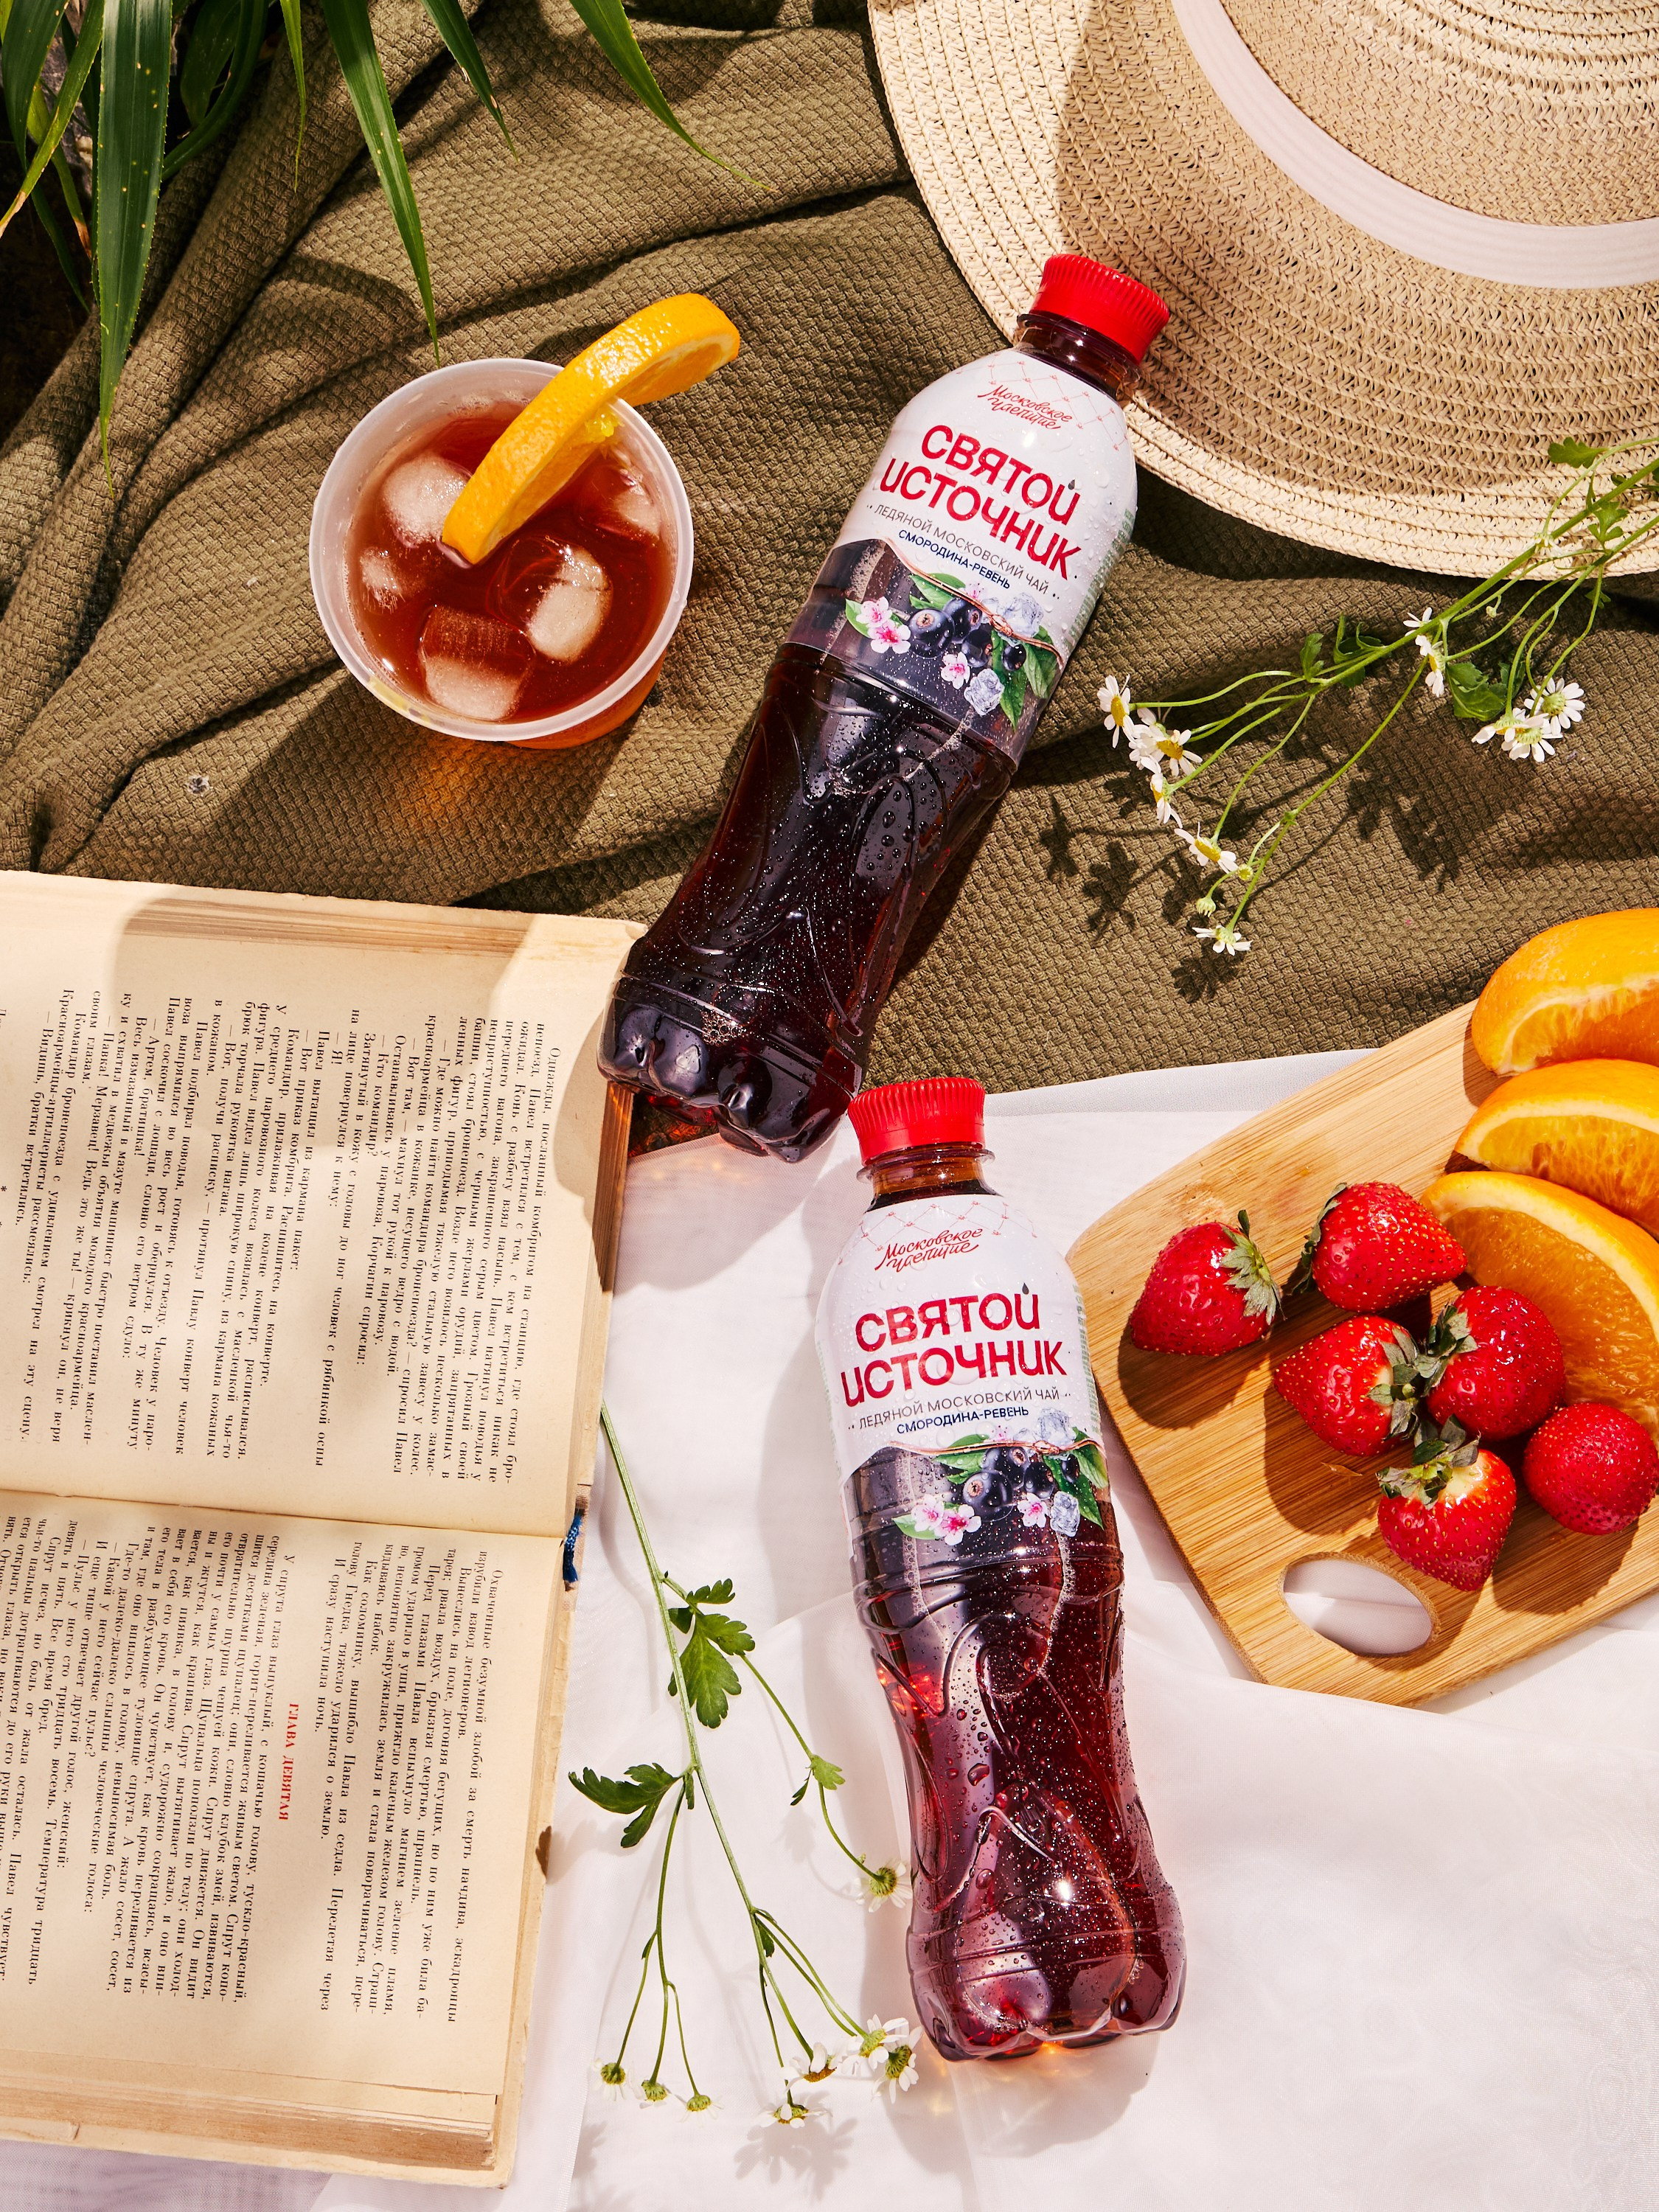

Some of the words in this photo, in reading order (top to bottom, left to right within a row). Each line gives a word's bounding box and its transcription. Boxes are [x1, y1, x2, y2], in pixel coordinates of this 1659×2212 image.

[978, 384, 1073, 422] Московское
[921, 425, 1081, 526] СВЯТОЙ
[880, 457, 1082, 581] ИСТОЧНИК
[874, 504, 933, 533] ЛЕДЯНОЙ
[933, 526, 1026, 580] МОСКОВСКИЙ
[1025, 572, 1048, 595] ЧАЙ
[898, 529, 1012, 590] СМОРОДИНА-РЕВЕНЬ
[120, 993, 132, 1009] ку
[113, 1031, 127, 1082] схватил
[192, 1021, 209, 1061] Павел
[278, 1029, 300, 1099] Командир,
[314, 1031, 330, 1070] Павел
[417, 1015, 437, 1116] красноармейца
[468, 1018, 486, 1065] башни,
[499, 1020, 514, 1087] переднего
[35, 989, 74, 1190] Красноармейцы-артиллеристы
[183, 1068, 200, 1129] подбирал
[384, 1035, 407, 1144] Останавливаясь
[465, 1073, 477, 1110] стоял
[542, 1048, 561, 1113] Однажды,
[307, 1079, 321, 1138] вытащил
[492, 1097, 506, 1146] вагона,
[101, 1105, 117, 1167] медвежьи
[268, 1112, 287, 1193] прилаживая
[304, 1146, 313, 1160] из
[455, 1119, 476, 1197] бронепоезд.
[535, 1123, 550, 1197] посланный
[174, 1136, 191, 1191] поводья,
[407, 1139, 423, 1200] кожанке,
[92, 1175, 110, 1228] объятия
[265, 1206, 275, 1220] на
[296, 1168, 310, 1222] кармана
[372, 1166, 389, 1227] паровоза,
[482, 1156, 500, 1249] закрашенного
[22, 1197, 42, 1284] рассмеялись:
[167, 1197, 182, 1253] готовясь
[290, 1230, 303, 1270] пакет:
[400, 1207, 415, 1270] несущего
[451, 1206, 467, 1244] Возле
[526, 1206, 542, 1276] комбригом
[874, 1228, 983, 1270] Московское
[83, 1236, 99, 1295] молодого
[165, 1260, 173, 1268] к
[258, 1233, 271, 1277] колене
[364, 1236, 384, 1299] Корчагин
[447, 1251, 457, 1280] него
[476, 1259, 488, 1299] серым
[155, 1273, 171, 1328] отъезду.
[247, 1290, 263, 1345] конверт,
[392, 1277, 406, 1314] ведро
[439, 1288, 453, 1346] возилось
[523, 1285, 532, 1300] на
[855, 1282, 1040, 1352] СВЯТОЙ
[69, 1302, 90, 1410] красноармейца.
[356, 1306, 371, 1365] спросил:
[386, 1335, 400, 1377] водой.
[468, 1311, 482, 1361] цветом.
[515, 1309, 529, 1370] станцию,
[149, 1337, 167, 1393] Человек
[431, 1355, 445, 1425] несколько
[511, 1379, 521, 1400] где
[841, 1340, 1068, 1408] ИСТОЧНИК
[145, 1398, 156, 1407] у
[237, 1359, 255, 1459] расписывался.
[461, 1372, 479, 1430] Грозный
[507, 1408, 518, 1446] стоял
[859, 1400, 923, 1429] ЛЕДЯНОЙ
[928, 1387, 1032, 1412] МОСКОВСКИЙ
[1035, 1386, 1060, 1401] ЧАЙ
[897, 1405, 1029, 1434] СМОРОДИНА-РЕВЕНЬ
[457, 1441, 468, 1479] своей
[63, 1520, 78, 1556] девять
[95, 1540, 108, 1549] И
[122, 1543, 140, 1581] Где-то
[250, 1534, 265, 1568] шится
[262, 1535, 280, 1586] середина
[334, 1559, 347, 1567] И
[89, 1556, 101, 1580] еще
[363, 1560, 378, 1584] Как
[376, 1544, 394, 1605] кидываясь
[422, 1565, 441, 1601] Перед
[441, 1548, 456, 1581] тарея;
[53, 1576, 66, 1609] пять.
[84, 1587, 97, 1621] тише
[239, 1573, 257, 1642] десятками
[325, 1574, 340, 1609] сразу
[437, 1588, 449, 1625] рвала
[482, 1570, 504, 1649] Охваченные
[49, 1618, 64, 1642] Все
[108, 1587, 128, 1685] далеко-далеко
[254, 1591, 270, 1647] зеленая,
[351, 1592, 369, 1669] соломинку,
[370, 1613, 384, 1655] набок.
[416, 1613, 431, 1668] глазами
[44, 1650, 56, 1691] время
[76, 1628, 90, 1688] отвечает
[319, 1617, 334, 1688] наступила
[429, 1633, 444, 1683] воздух,
[229, 1649, 246, 1715] щупалец;
[411, 1682, 427, 1724] Павла
[475, 1658, 492, 1723] безумной
[38, 1699, 53, 1733] бред.
[69, 1694, 83, 1742] другой
[100, 1692, 114, 1752] слышны
[226, 1722, 238, 1751] они,
[240, 1655, 262, 1793] горит-переливается
[285, 1703, 299, 1748] ГЛАВА
[314, 1697, 326, 1733] ночь.
[345, 1679, 360, 1744] вышибло
[425, 1691, 441, 1748] брызгая
[62, 1751, 77, 1793] голос,
[340, 1754, 356, 1798] Павла
[402, 1737, 418, 1815] вспыхнуло
[470, 1731, 483, 1778] злобой
[90, 1760, 108, 1854] человеческие
[223, 1759, 234, 1807] словно
[278, 1755, 294, 1820] ДЕВЯТАЯ
[417, 1756, 432, 1820] смертью,
[467, 1787, 477, 1801] за
[57, 1801, 72, 1868] женский:
[216, 1813, 230, 1863] клубок
[234, 1800, 247, 1850] живым
[338, 1808, 347, 1824] из
[461, 1810, 475, 1859] смерть
[228, 1856, 241, 1907] светом.
[333, 1834, 345, 1877] седла.
[396, 1828, 409, 1888] магнием
[410, 1829, 425, 1905] шрапнель.
[84, 1863, 97, 1913] голоса:
[210, 1868, 225, 1906] змей,
[454, 1868, 470, 1929] начдива,
[221, 1913, 240, 1958] Спрут
[325, 1888, 344, 1962] Перелетая
[390, 1900, 403, 1955] зеленое
[200, 1913, 219, 2000] извиваются,
[447, 1938, 463, 2023] эскадронцы
[319, 1972, 332, 2011] через
[383, 1968, 396, 2015] пламя,
